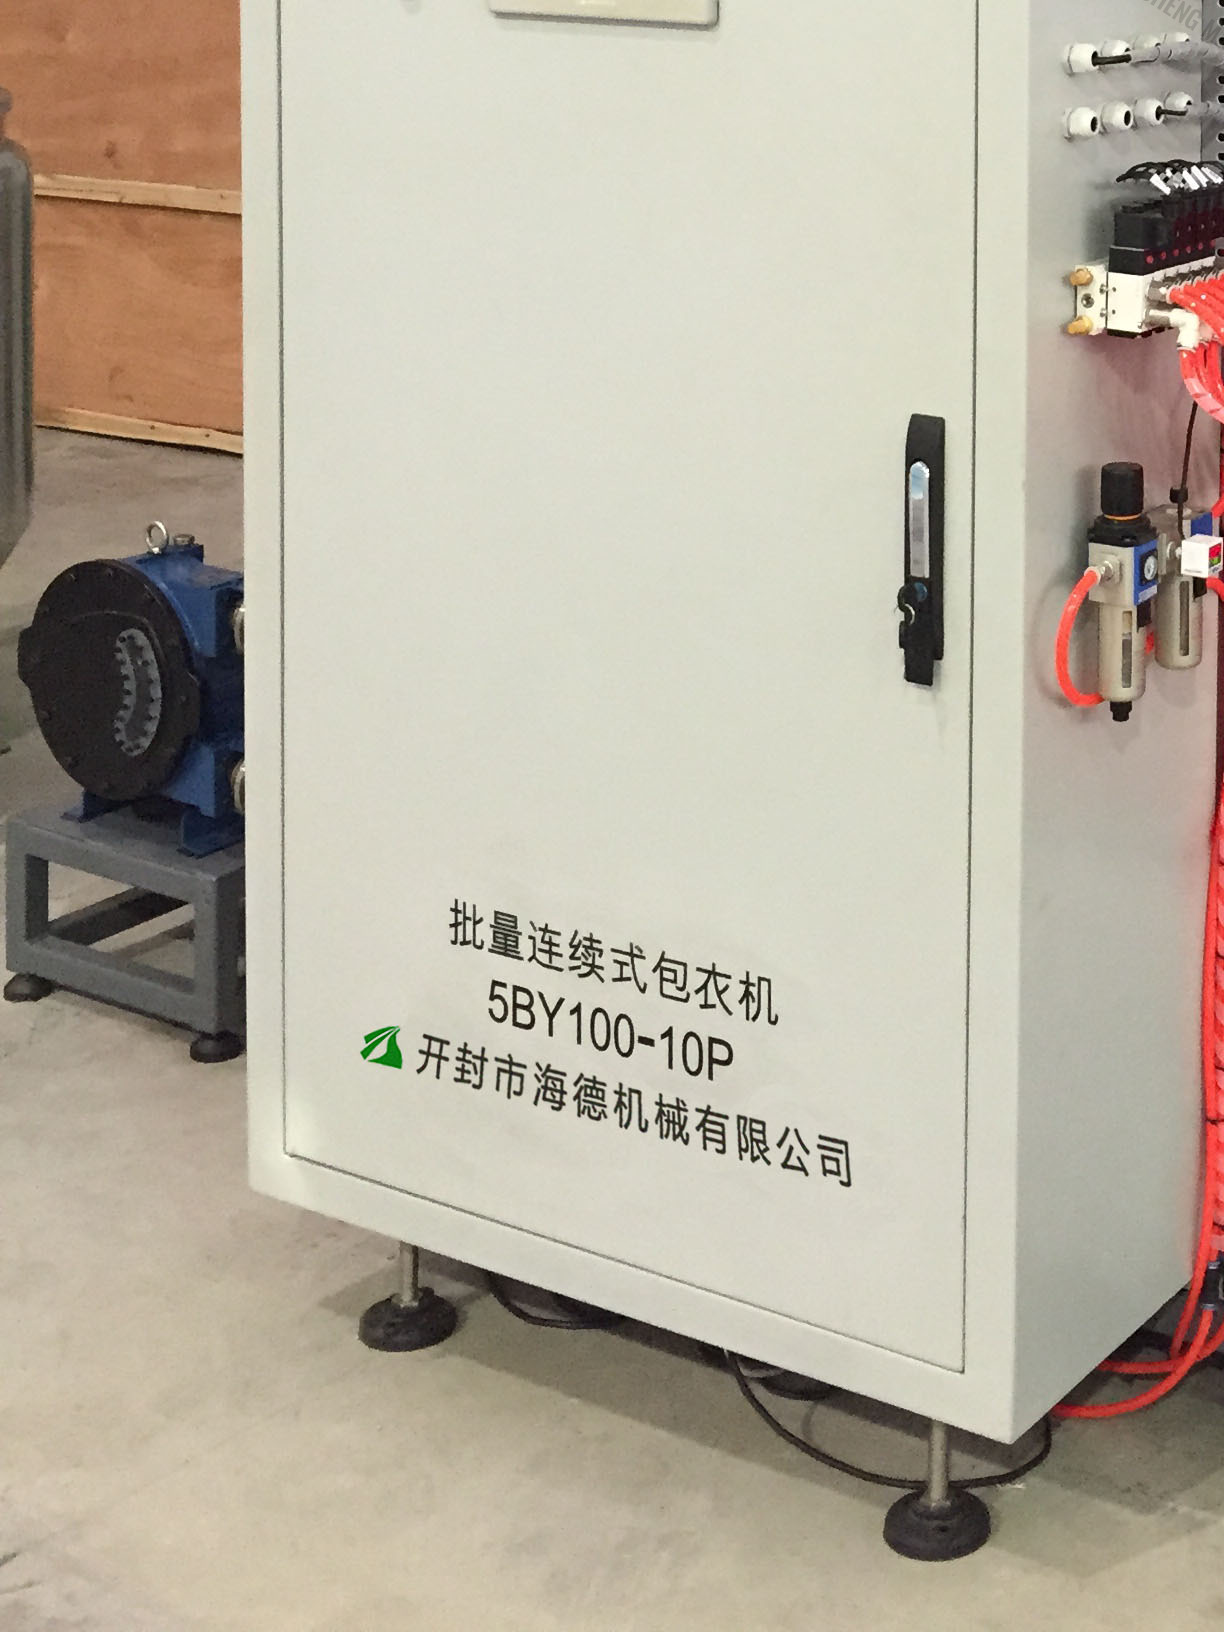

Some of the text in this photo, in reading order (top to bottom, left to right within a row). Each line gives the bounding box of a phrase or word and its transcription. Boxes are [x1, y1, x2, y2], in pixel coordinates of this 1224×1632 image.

[449, 898, 778, 1025] 批量连续式包衣机
[488, 979, 733, 1081] 5BY100-10P
[416, 1034, 852, 1187] 开封市海德机械有限公司
